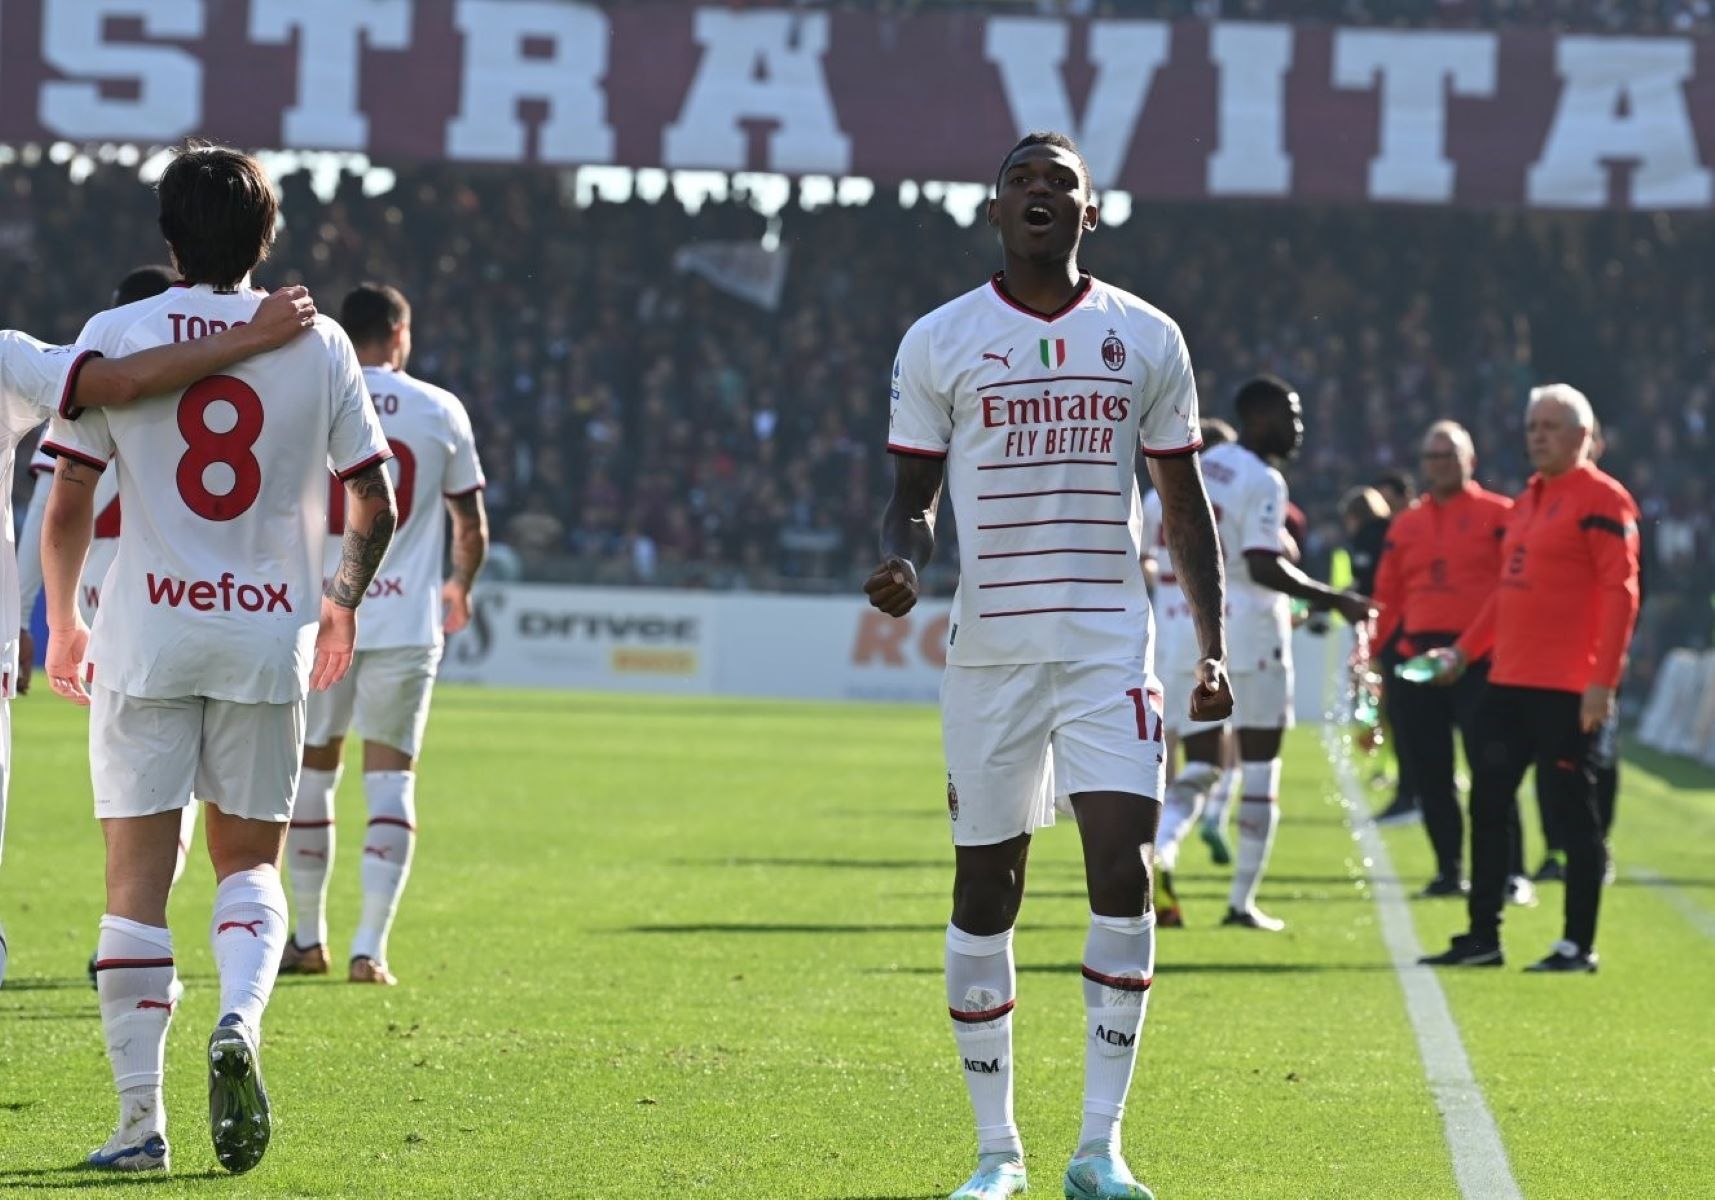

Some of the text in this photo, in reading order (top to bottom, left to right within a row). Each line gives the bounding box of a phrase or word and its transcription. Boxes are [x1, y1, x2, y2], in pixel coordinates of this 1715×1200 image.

[984, 19, 1712, 208] VITA
[982, 390, 1131, 428] Emirates
[176, 374, 264, 521] 8
[1004, 427, 1114, 457] FLY BETTER
[147, 572, 292, 613] wefox
[1096, 1024, 1136, 1048] ACM
[964, 1057, 999, 1073] ACM
